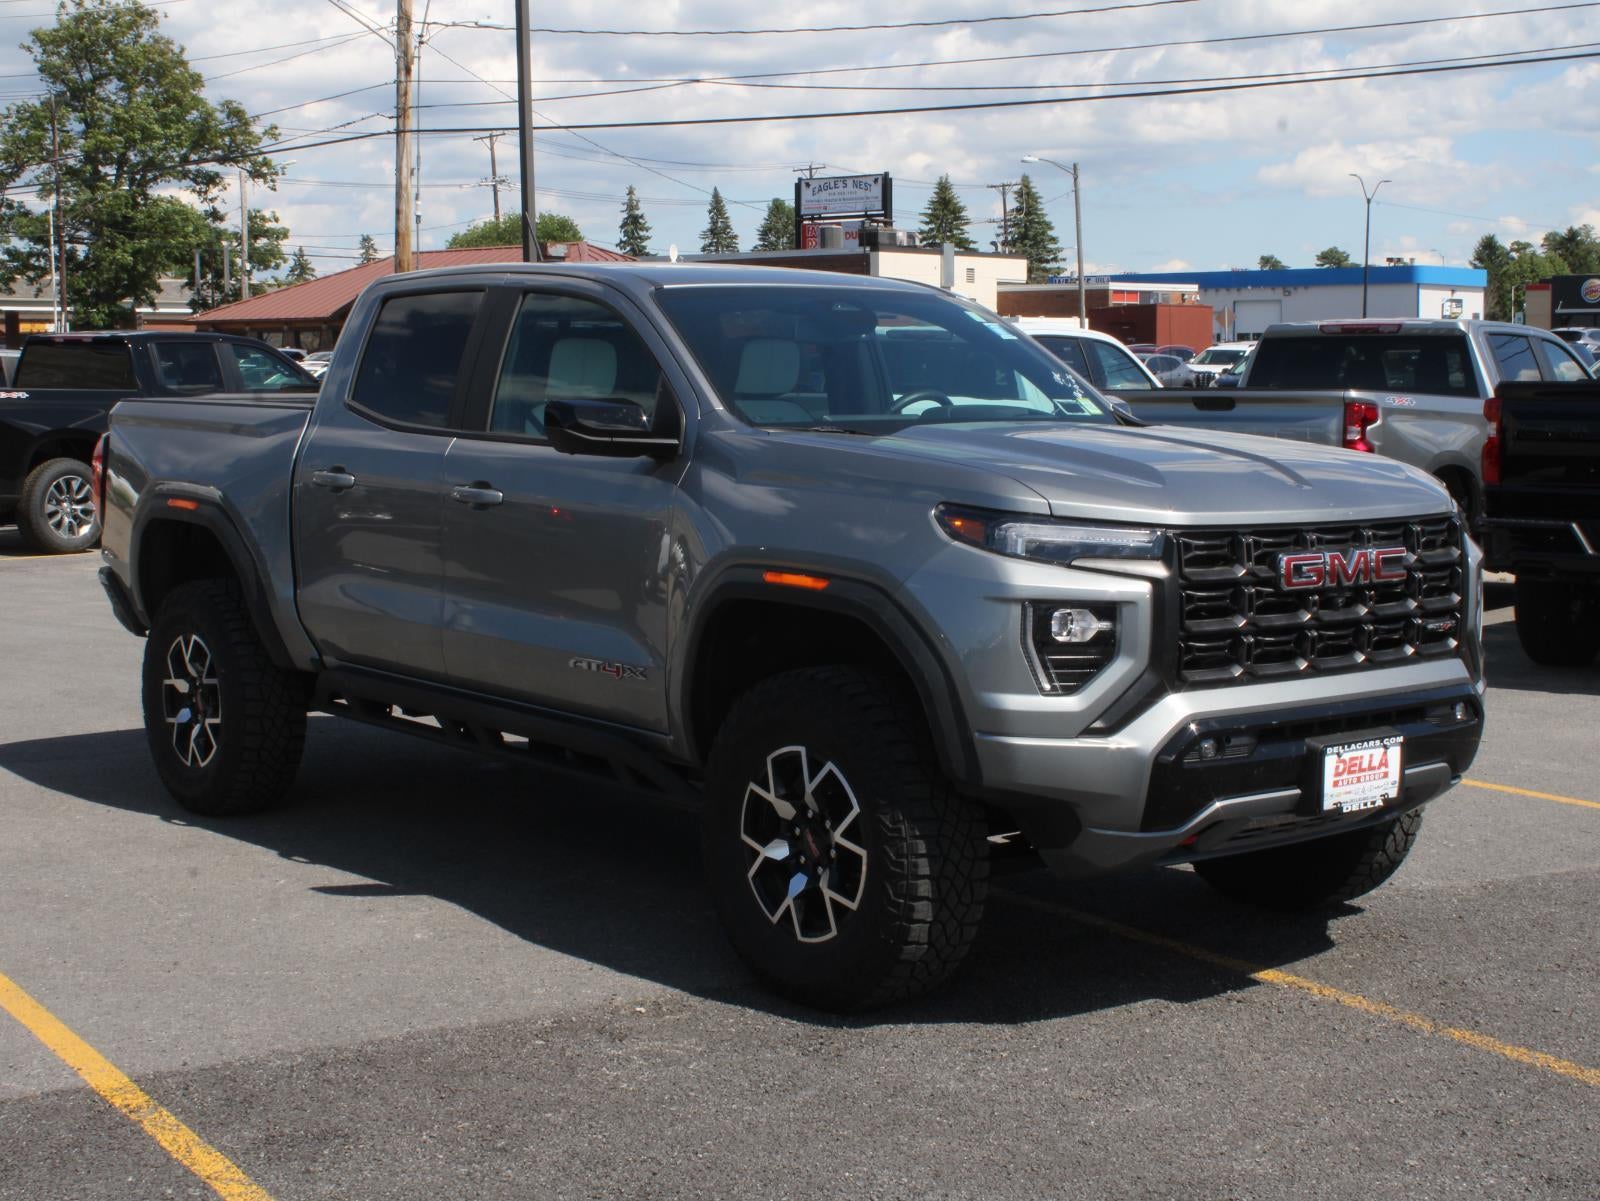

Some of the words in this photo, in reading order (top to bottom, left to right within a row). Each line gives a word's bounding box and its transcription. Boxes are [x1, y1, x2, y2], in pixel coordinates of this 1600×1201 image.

[812, 180, 848, 197] EAGLE'S
[852, 180, 873, 193] NEST
[1279, 546, 1407, 591] GMC
[568, 656, 648, 680] AT4X
[1326, 736, 1404, 754] DELLACARS.COM
[1333, 750, 1389, 778] DELLA
[1337, 777, 1358, 787] AUTO
[1360, 773, 1385, 784] GROUP
[1342, 799, 1384, 813] DELLA
